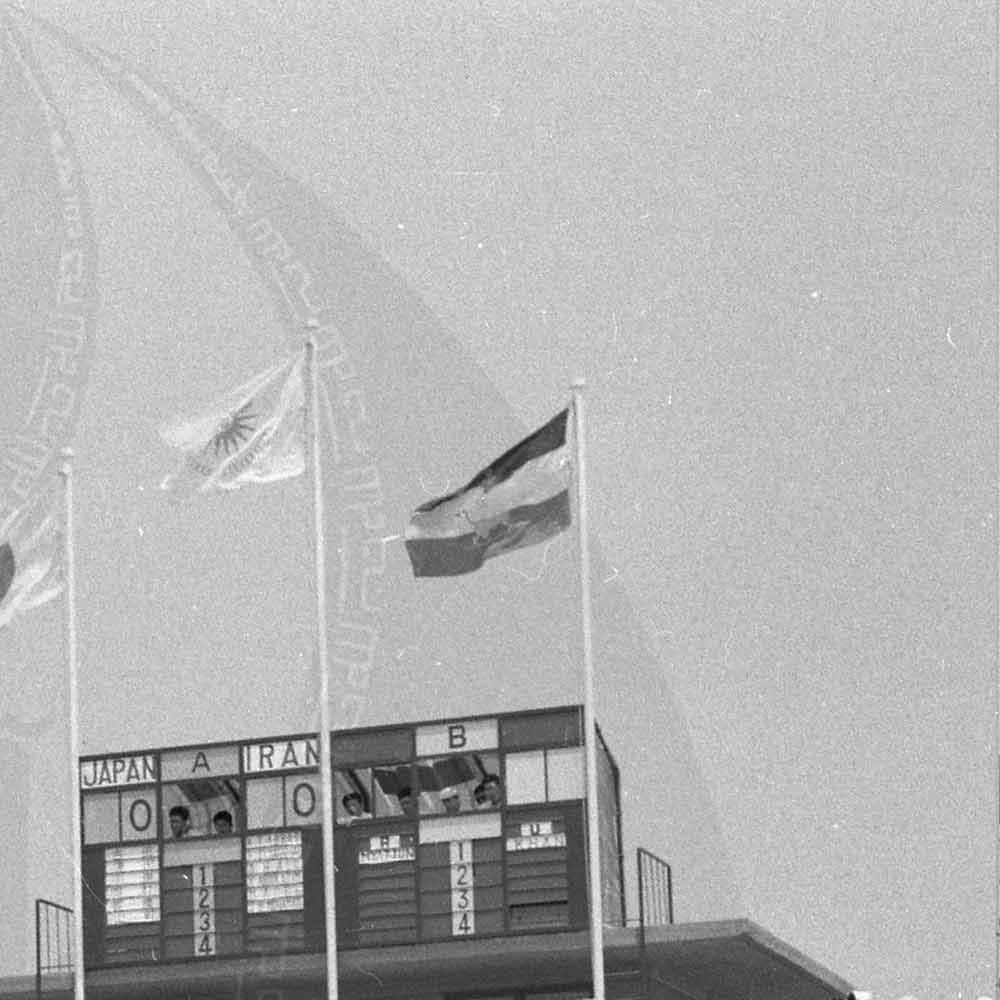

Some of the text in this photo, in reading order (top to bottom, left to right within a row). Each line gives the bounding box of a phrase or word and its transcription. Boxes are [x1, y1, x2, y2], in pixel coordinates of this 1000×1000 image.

[449, 725, 466, 749] B
[192, 752, 210, 773] A
[246, 740, 321, 771] IRAN
[82, 755, 158, 787] JAPAN
[458, 843, 464, 861] 1
[200, 867, 206, 885] 1
[457, 866, 467, 885] 2
[199, 888, 209, 908] 2
[458, 890, 469, 909] 3
[199, 912, 210, 931] 3
[458, 913, 471, 933] 4
[199, 936, 212, 954] 4
